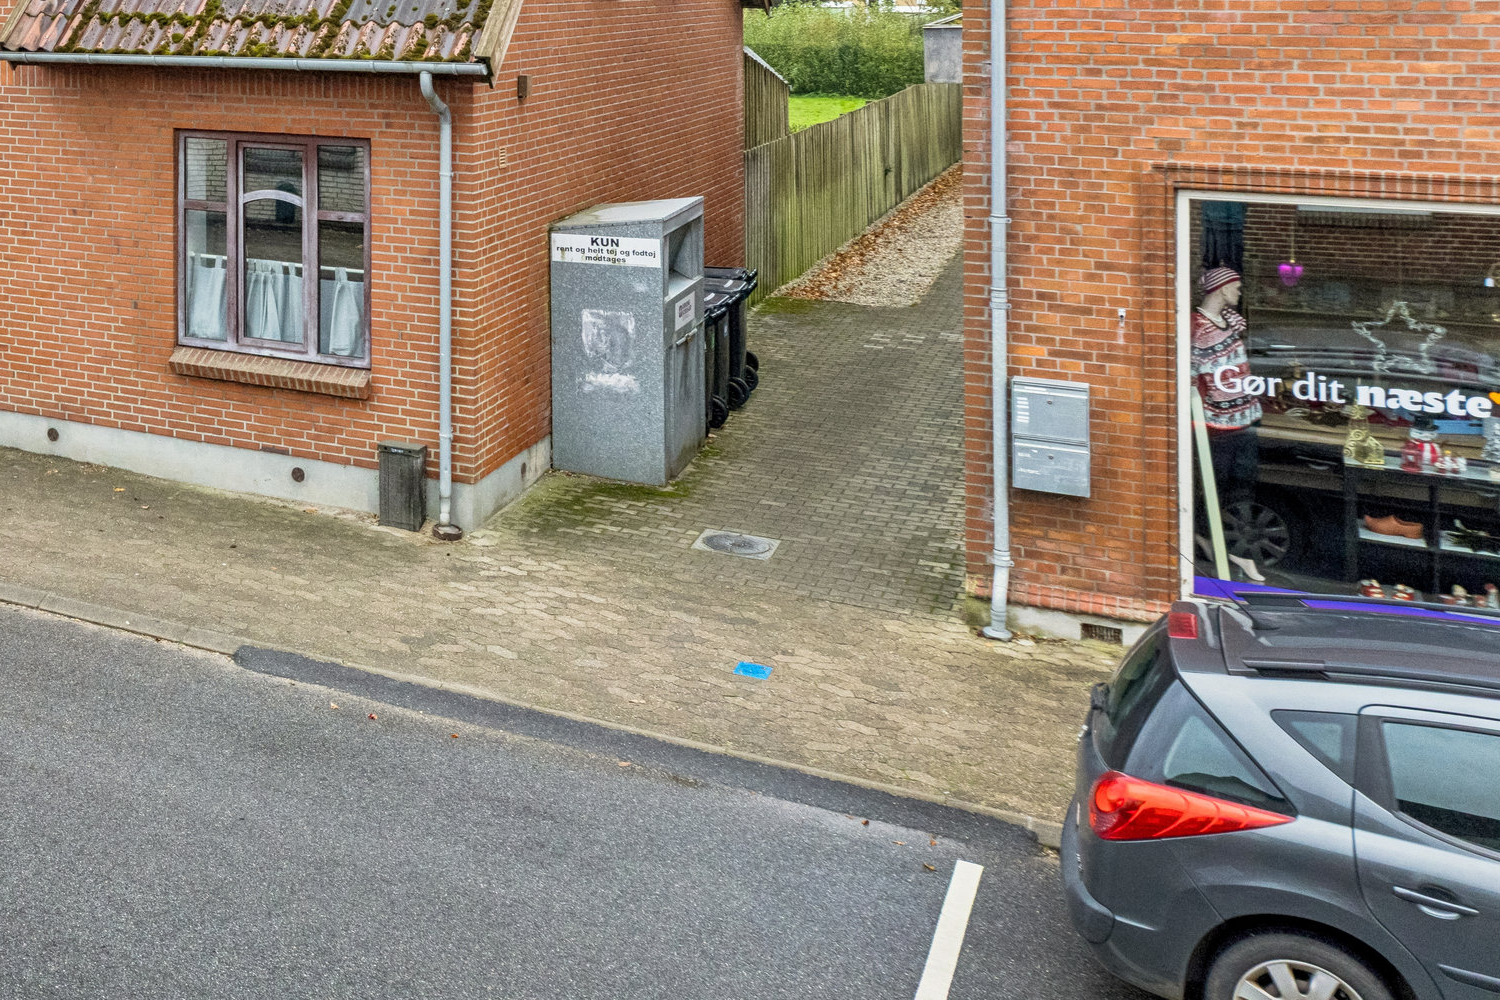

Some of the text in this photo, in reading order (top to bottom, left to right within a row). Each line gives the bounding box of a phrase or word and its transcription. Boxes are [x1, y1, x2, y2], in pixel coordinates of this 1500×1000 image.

[590, 237, 620, 248] KUN
[606, 248, 618, 256] tøj
[585, 255, 627, 264] modtages
[1214, 365, 1493, 418] Gør dit næste
